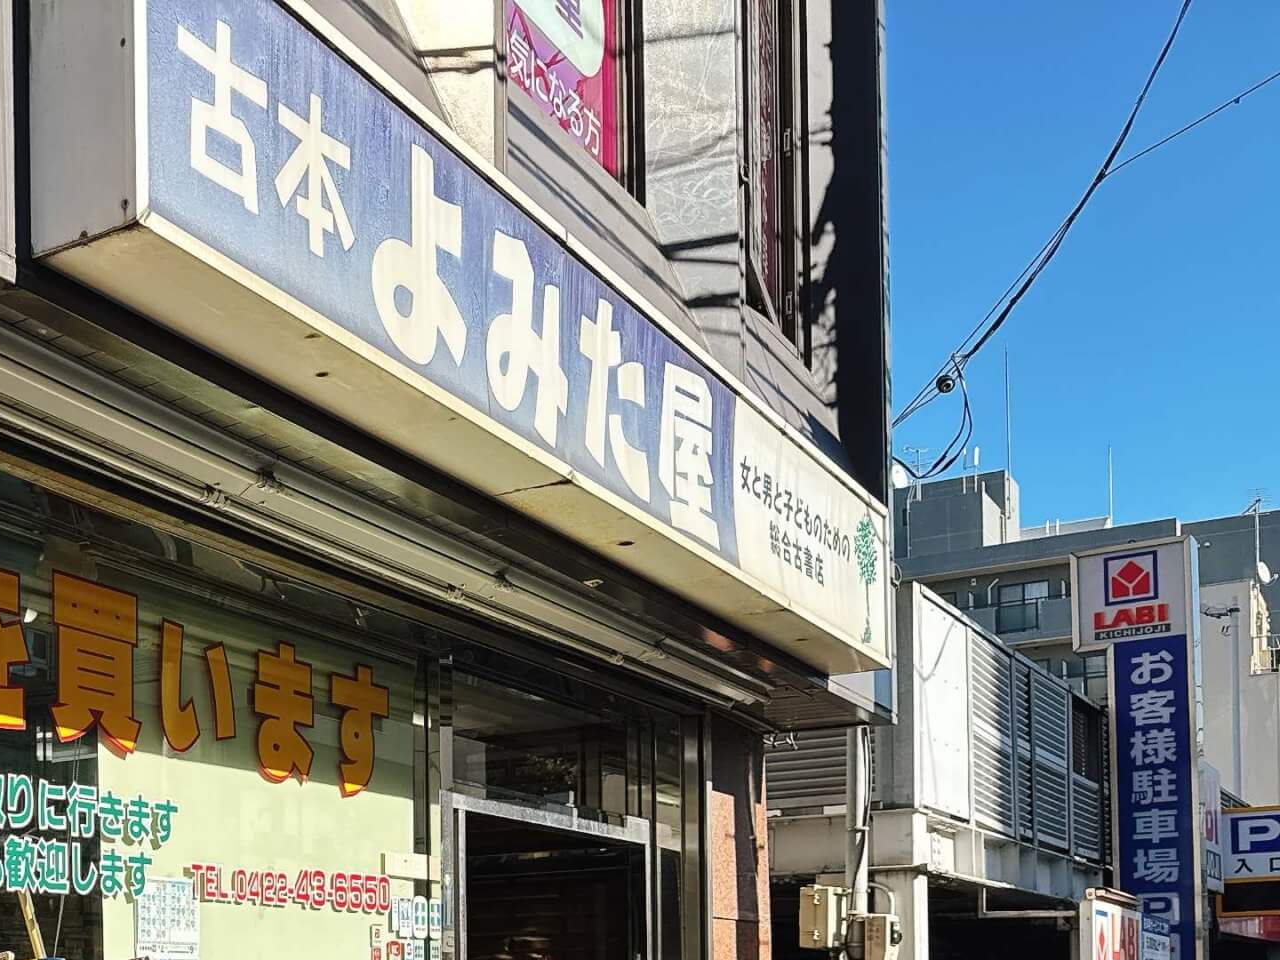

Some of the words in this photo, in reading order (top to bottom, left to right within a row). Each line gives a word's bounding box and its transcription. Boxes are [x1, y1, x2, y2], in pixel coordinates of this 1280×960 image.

[510, 30, 601, 156] 気になる方
[740, 456, 851, 562] 女と男と子どものための
[769, 520, 825, 587] 総合古書店
[1094, 603, 1169, 630] LABI
[1099, 625, 1166, 640] KICHIJOJI
[1129, 650, 1180, 884] お客様駐車場
